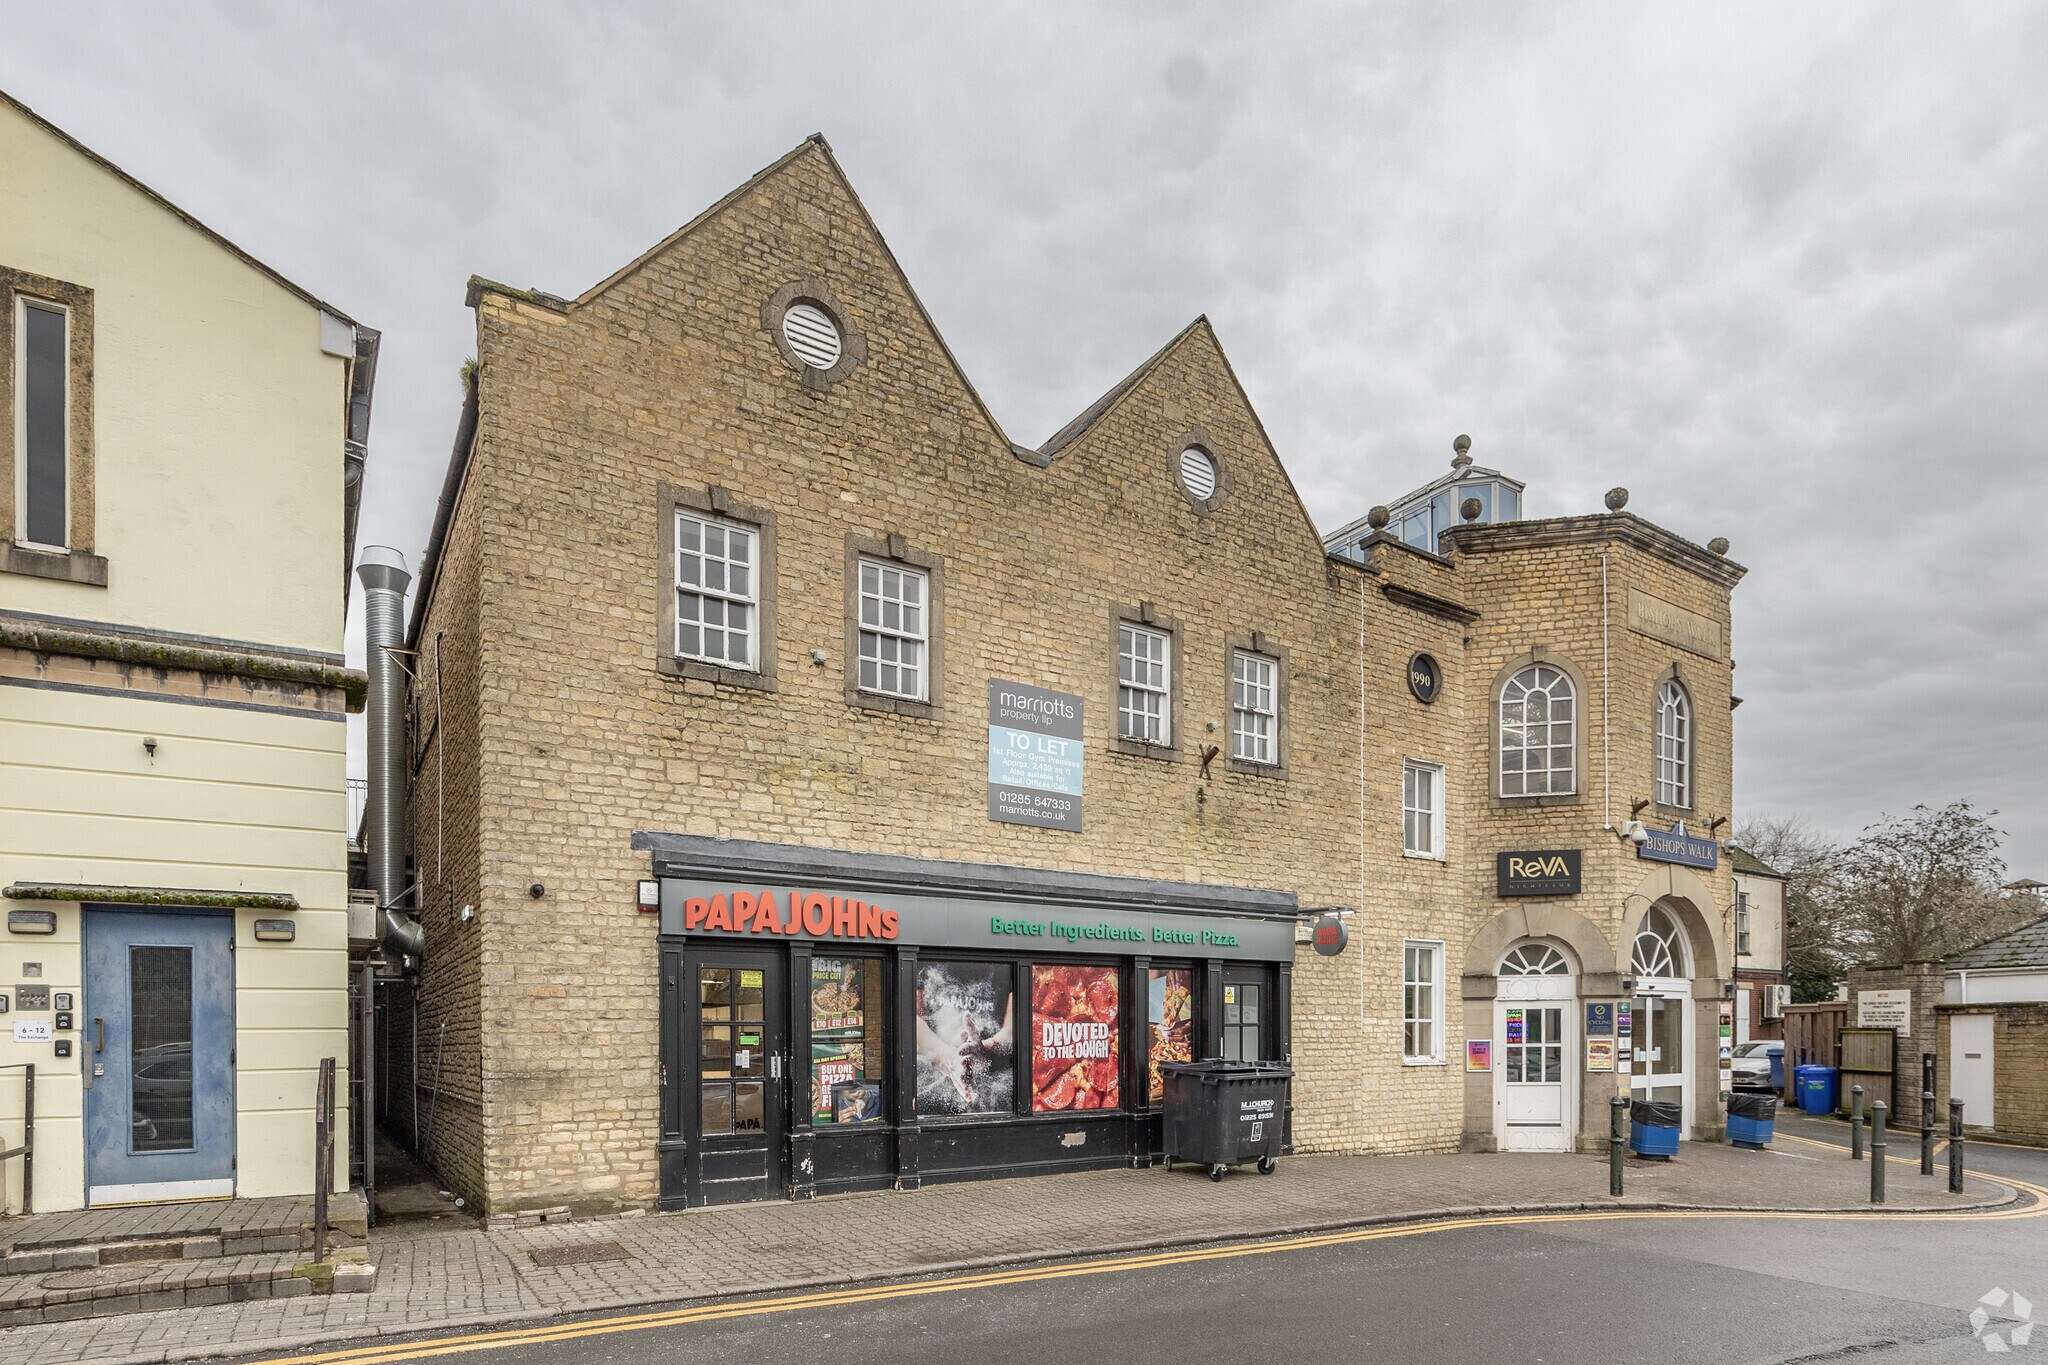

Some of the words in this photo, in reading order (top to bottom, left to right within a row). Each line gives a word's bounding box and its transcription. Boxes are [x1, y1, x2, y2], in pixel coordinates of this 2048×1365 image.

[1637, 602, 1682, 633] BISHOPS
[1000, 691, 1074, 719] marriotts
[1000, 707, 1040, 724] property
[1041, 714, 1053, 726] llp
[1006, 731, 1030, 750] TO
[1037, 737, 1069, 757] LET
[992, 747, 1004, 756] 1st
[1006, 748, 1026, 759] Floor
[1028, 752, 1046, 763] Gym
[1047, 755, 1081, 769] Premises
[1002, 757, 1030, 770] Approx.
[1032, 762, 1053, 772] 2,439
[1054, 767, 1064, 776] sq
[1065, 768, 1072, 776] ft
[1009, 767, 1025, 777] Also
[1027, 769, 1054, 782] suitable
[1055, 774, 1066, 783] for
[999, 791, 1031, 805] 01285
[1034, 796, 1072, 811] 647333
[999, 804, 1066, 821] marriotts.co.uk
[1646, 835, 1686, 856] BISHOPS
[1687, 843, 1714, 860] WALK
[685, 891, 783, 934] PAPA
[784, 891, 900, 940] JOHNS
[991, 915, 1046, 936] Better
[1050, 920, 1147, 943] Ingredients.
[1152, 927, 1198, 944] Better
[1201, 929, 1240, 946] Pizza.
[818, 958, 842, 972] BIG
[811, 971, 829, 979] PRICE
[829, 971, 842, 979] CUT
[1042, 1022, 1109, 1047] DEVOTED
[1043, 1046, 1056, 1059] TO
[1056, 1044, 1075, 1059] THE
[1075, 1040, 1109, 1059] DOUGH
[821, 1064, 837, 1074] BUY
[837, 1064, 853, 1074] ONE
[821, 1073, 853, 1085] PIZZA
[821, 1084, 832, 1095] GE
